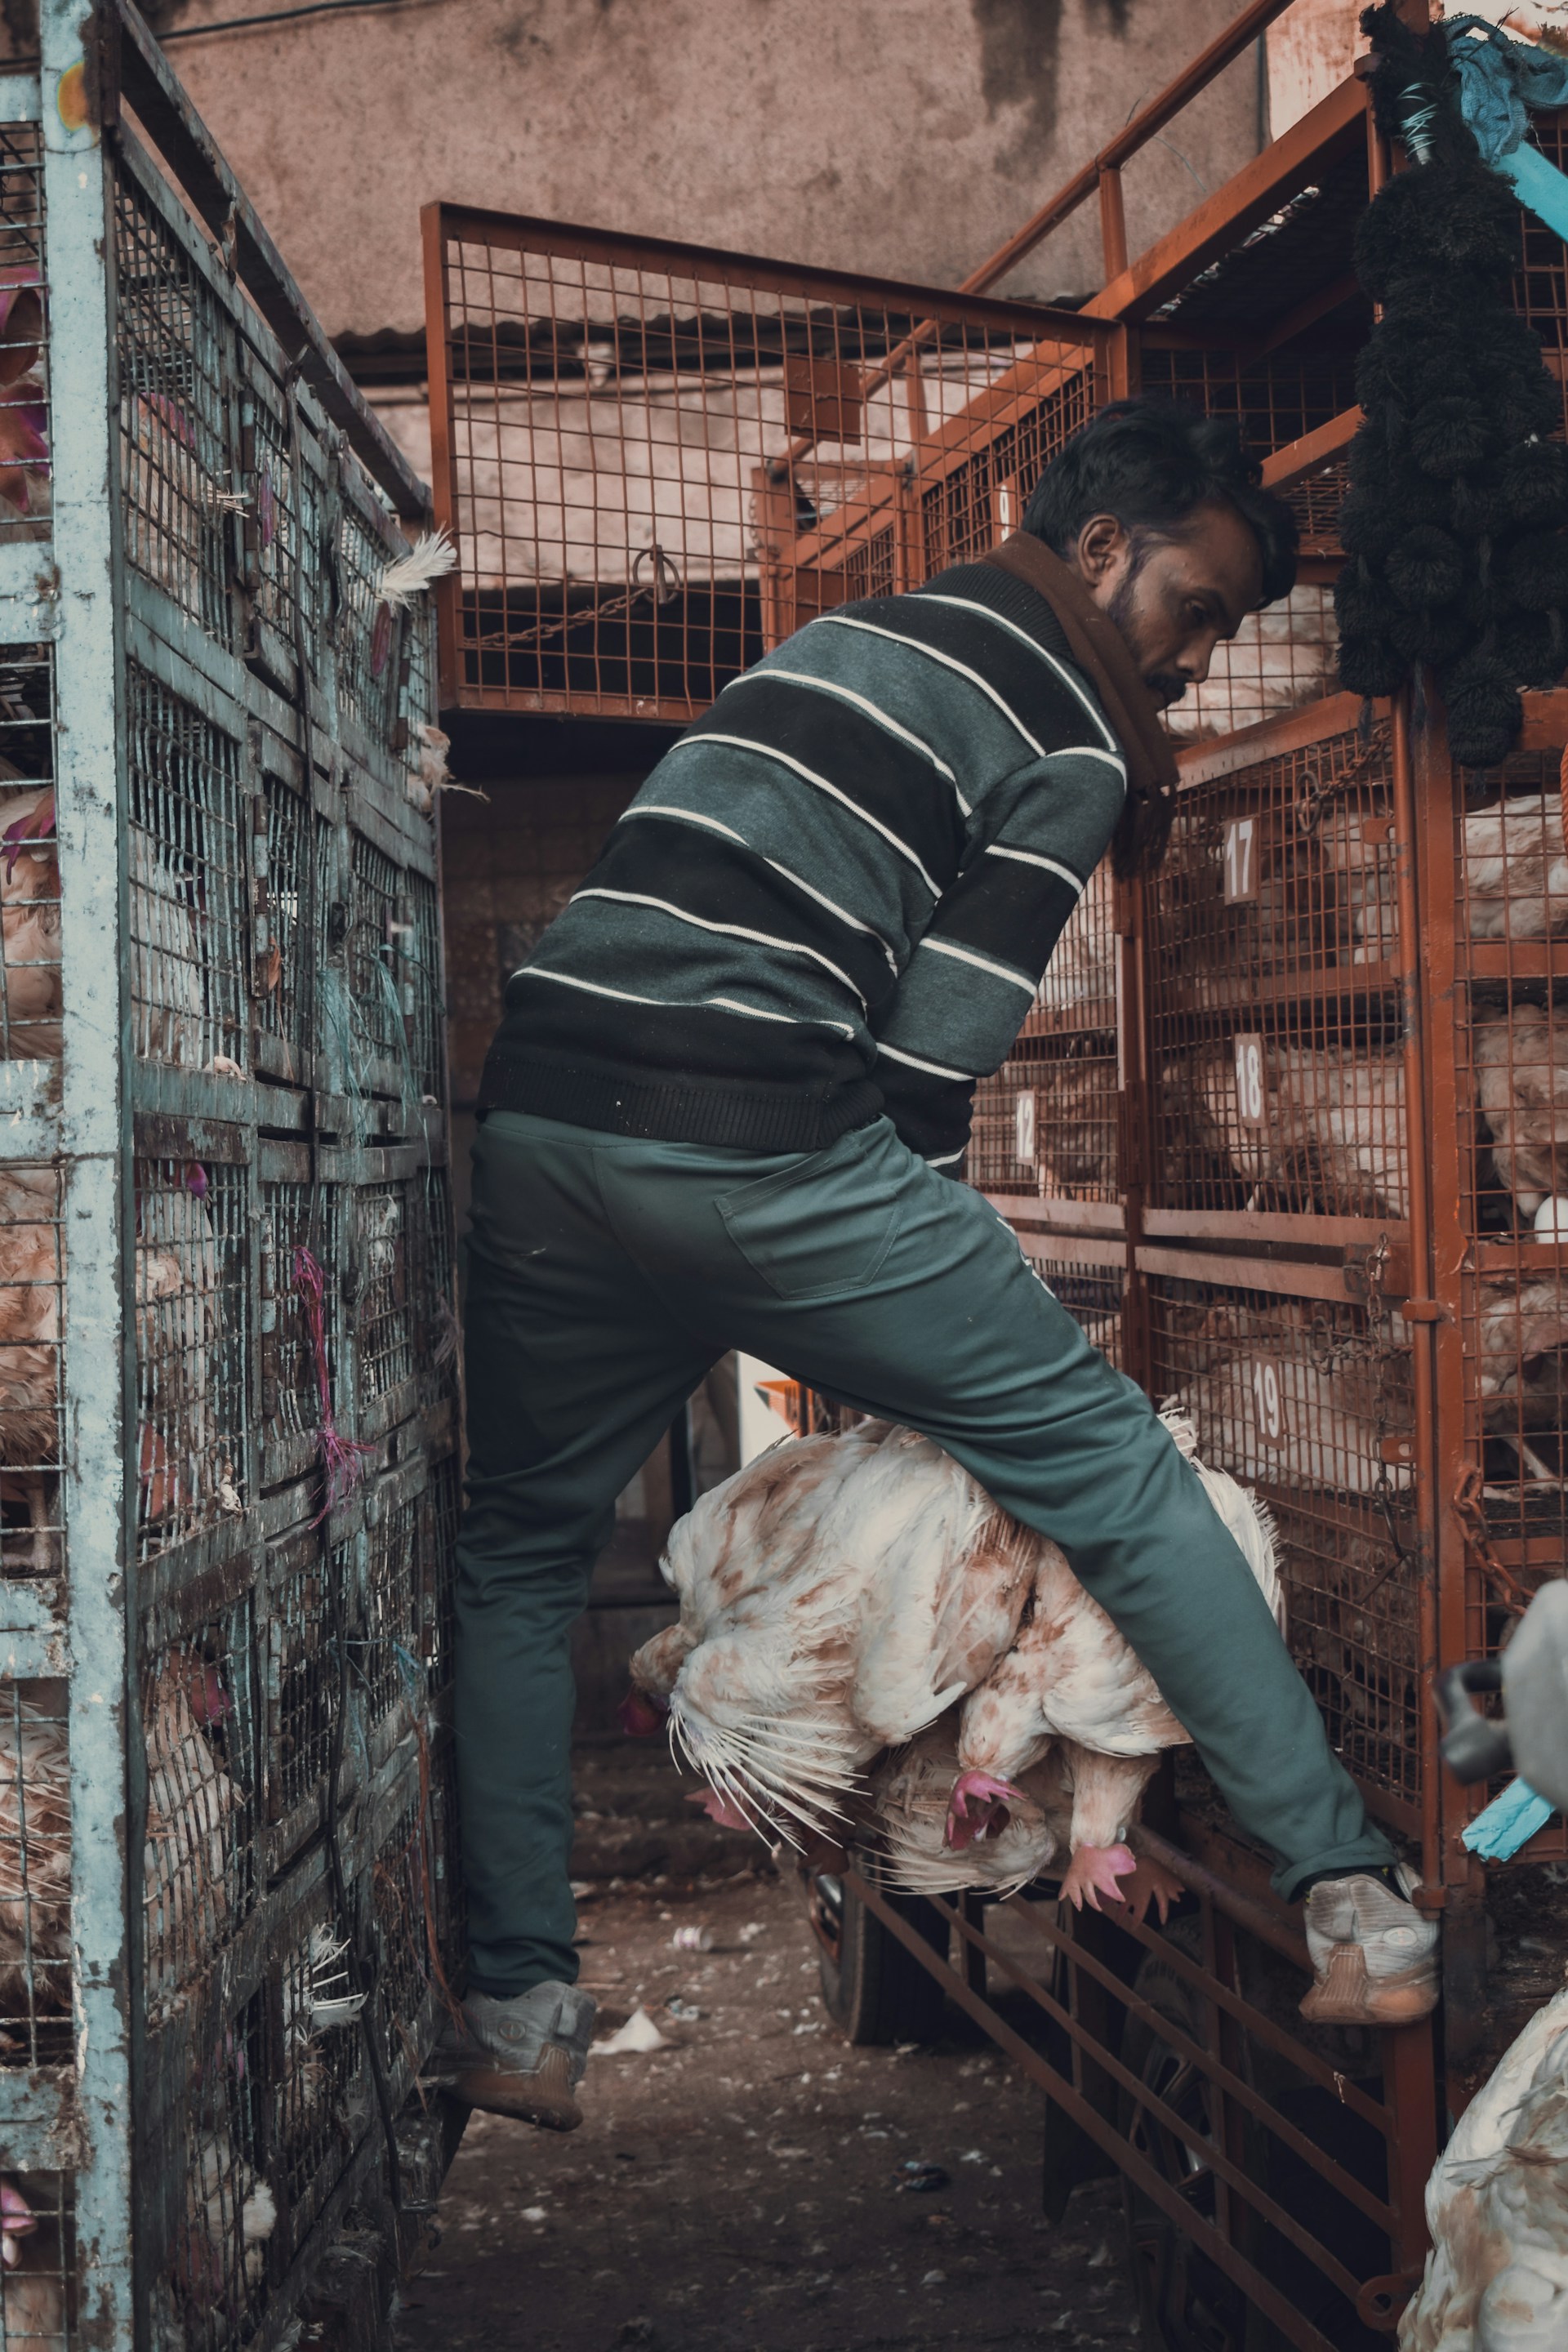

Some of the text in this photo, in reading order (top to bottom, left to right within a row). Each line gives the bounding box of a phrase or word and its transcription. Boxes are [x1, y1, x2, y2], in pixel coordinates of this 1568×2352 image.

[1000, 485, 1009, 542] 9
[1227, 819, 1253, 897] 17
[1236, 1045, 1261, 1118] 18
[1017, 1098, 1034, 1158] 12
[1254, 1361, 1279, 1439] 19
